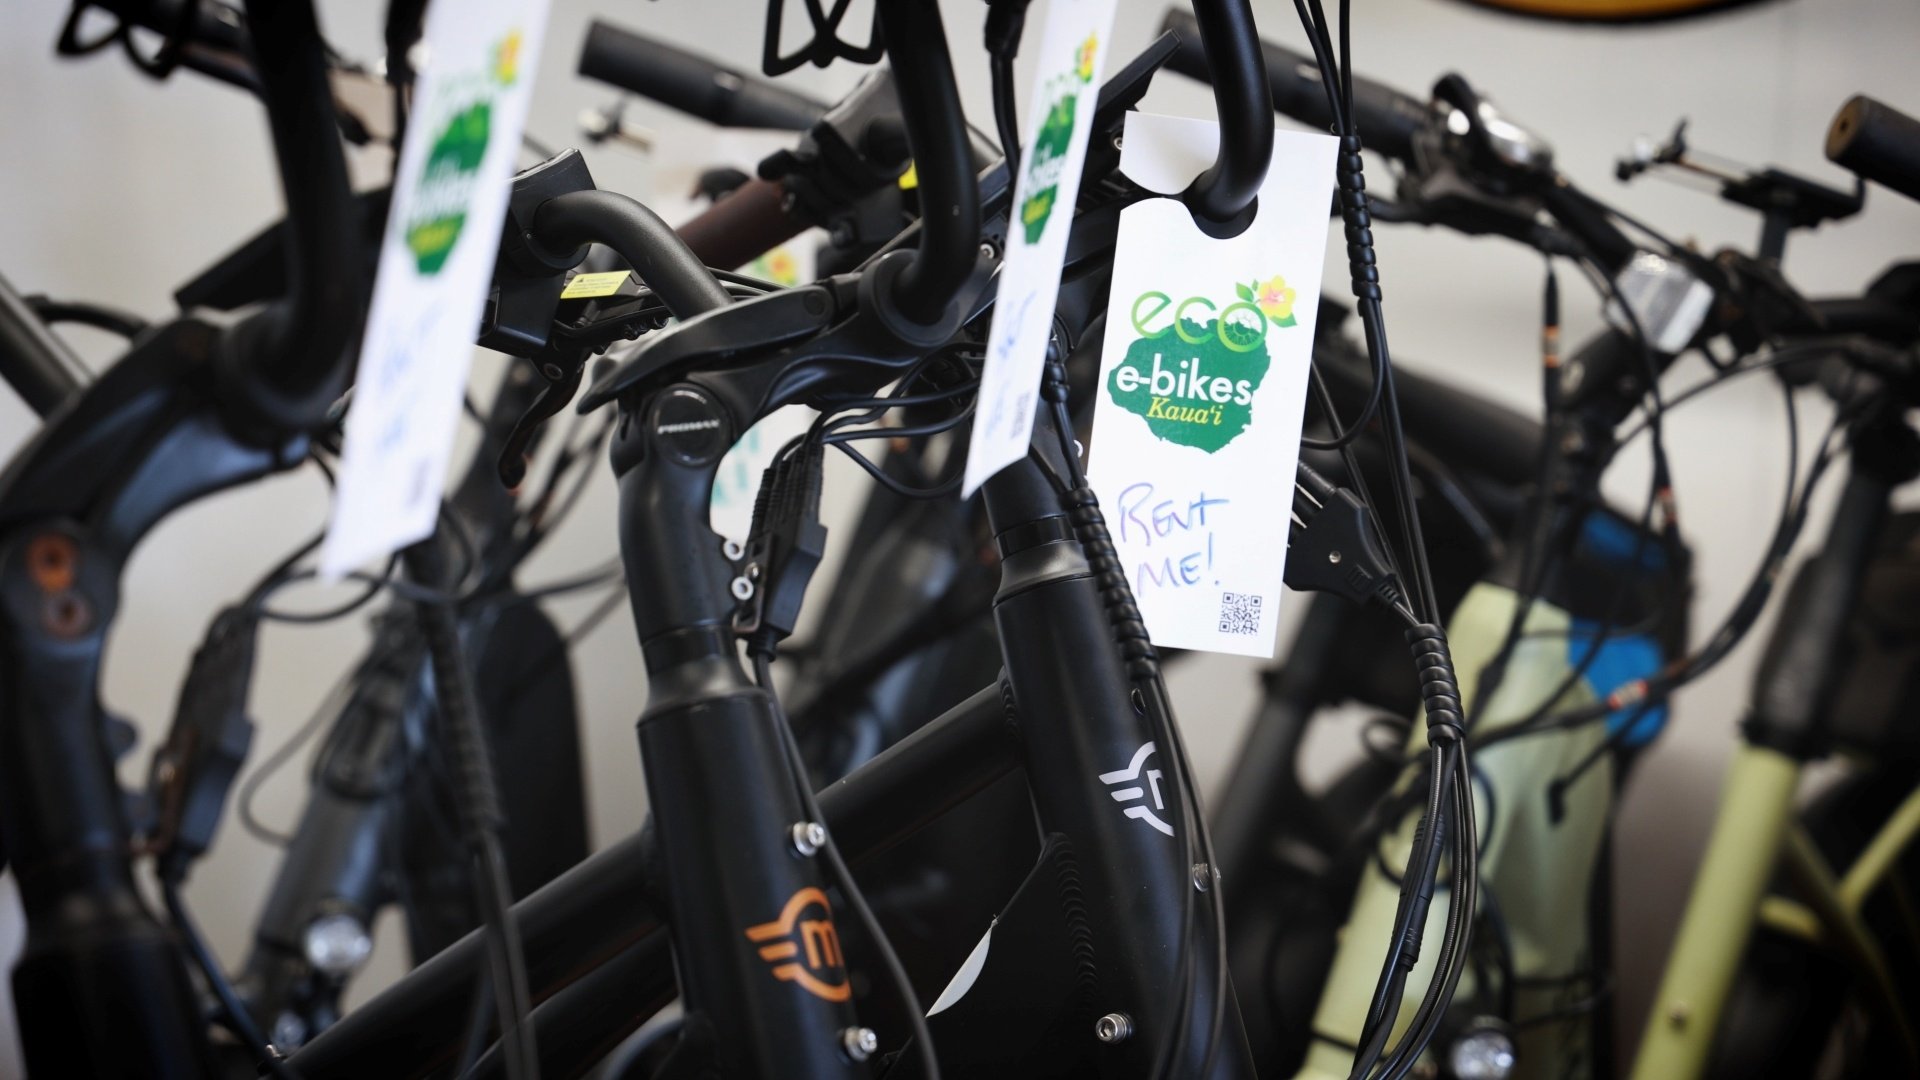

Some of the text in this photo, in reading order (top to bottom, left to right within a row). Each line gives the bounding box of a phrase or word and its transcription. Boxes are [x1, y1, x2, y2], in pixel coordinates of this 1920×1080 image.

[1131, 290, 1268, 353] eco
[1116, 353, 1252, 406] e-bikes
[1136, 532, 1220, 598] ME!
